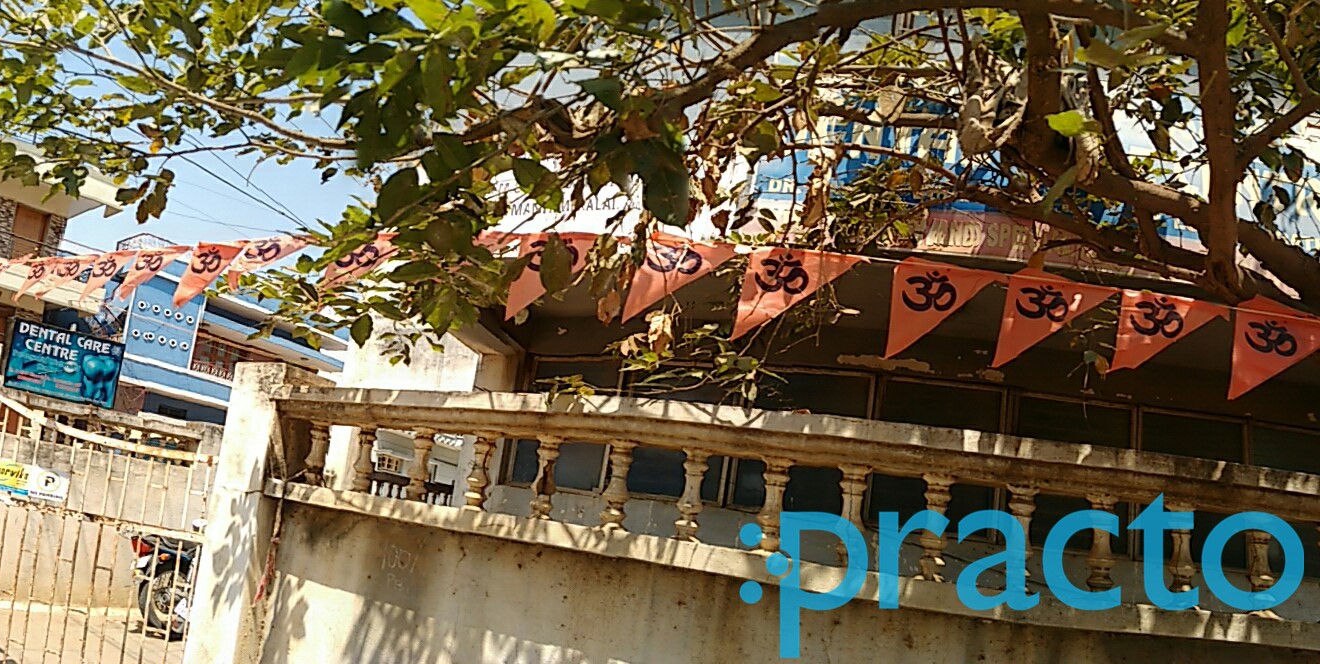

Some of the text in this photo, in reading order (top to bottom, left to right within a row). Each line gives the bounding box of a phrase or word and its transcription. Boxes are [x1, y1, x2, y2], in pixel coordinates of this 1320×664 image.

[18, 321, 112, 354] DENTAL CARE
[25, 338, 79, 361] CENTRE
